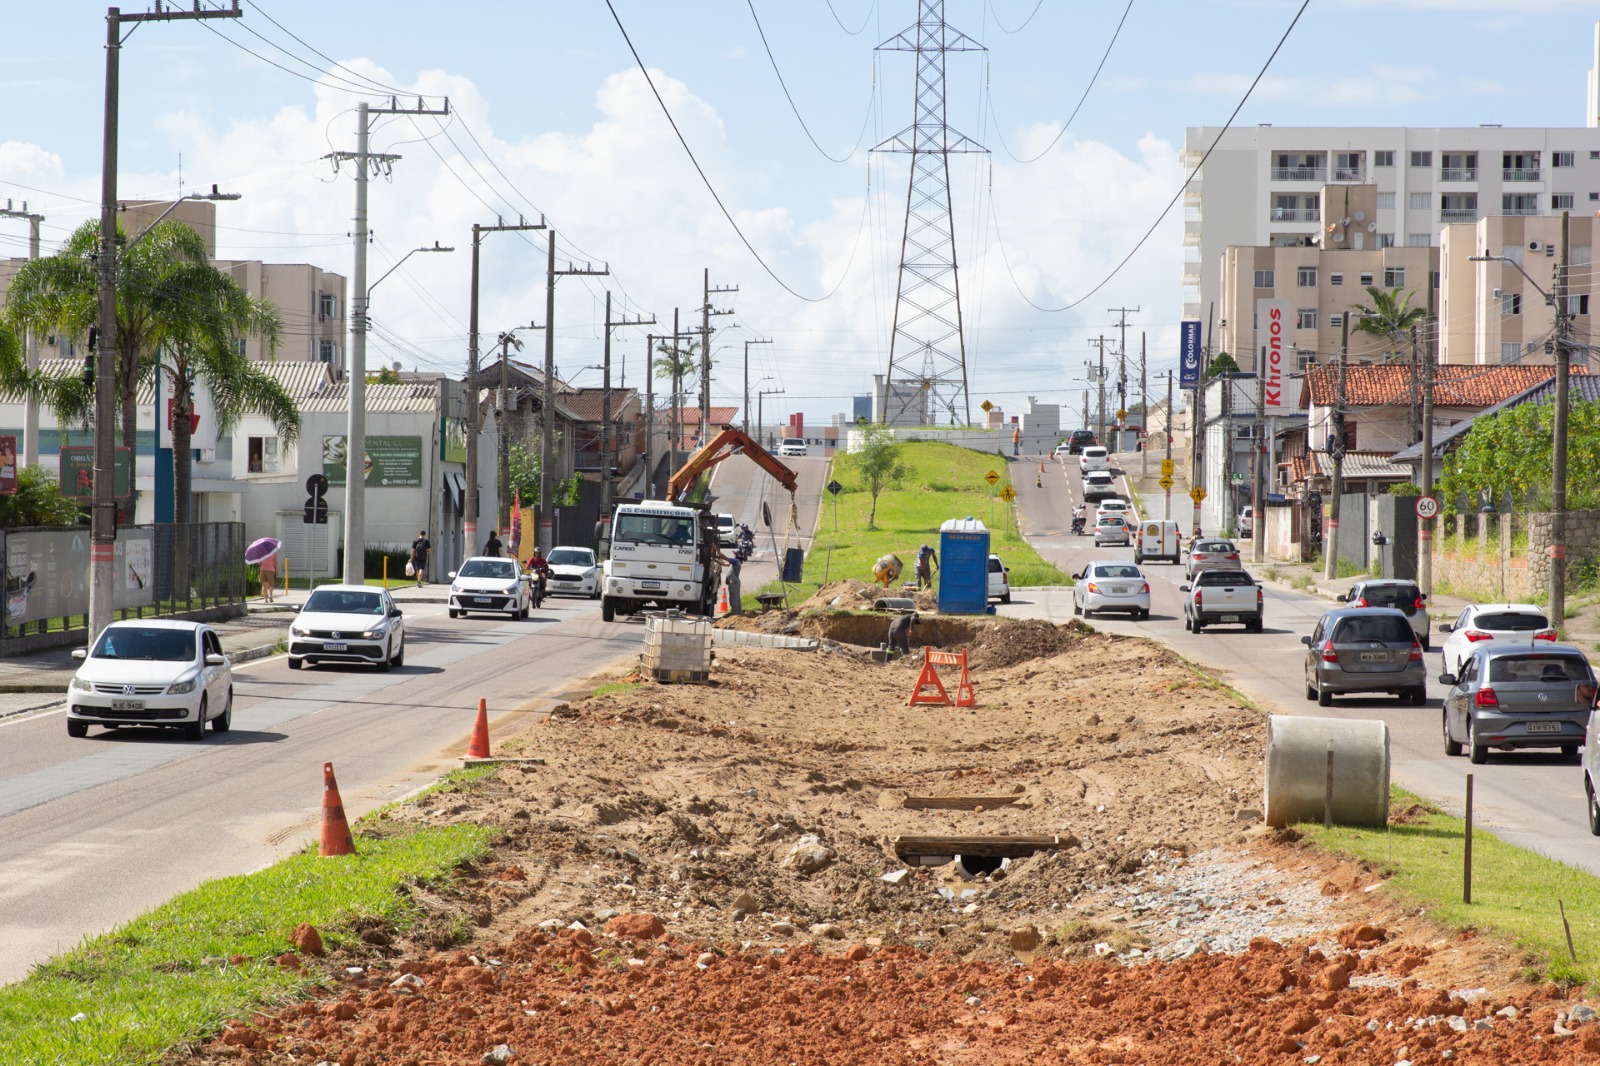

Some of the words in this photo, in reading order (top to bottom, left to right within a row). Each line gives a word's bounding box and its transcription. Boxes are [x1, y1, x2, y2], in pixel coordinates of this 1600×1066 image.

[1265, 308, 1281, 407] Khronos
[70, 454, 95, 462] ORGÂN
[1420, 501, 1434, 511] 60
